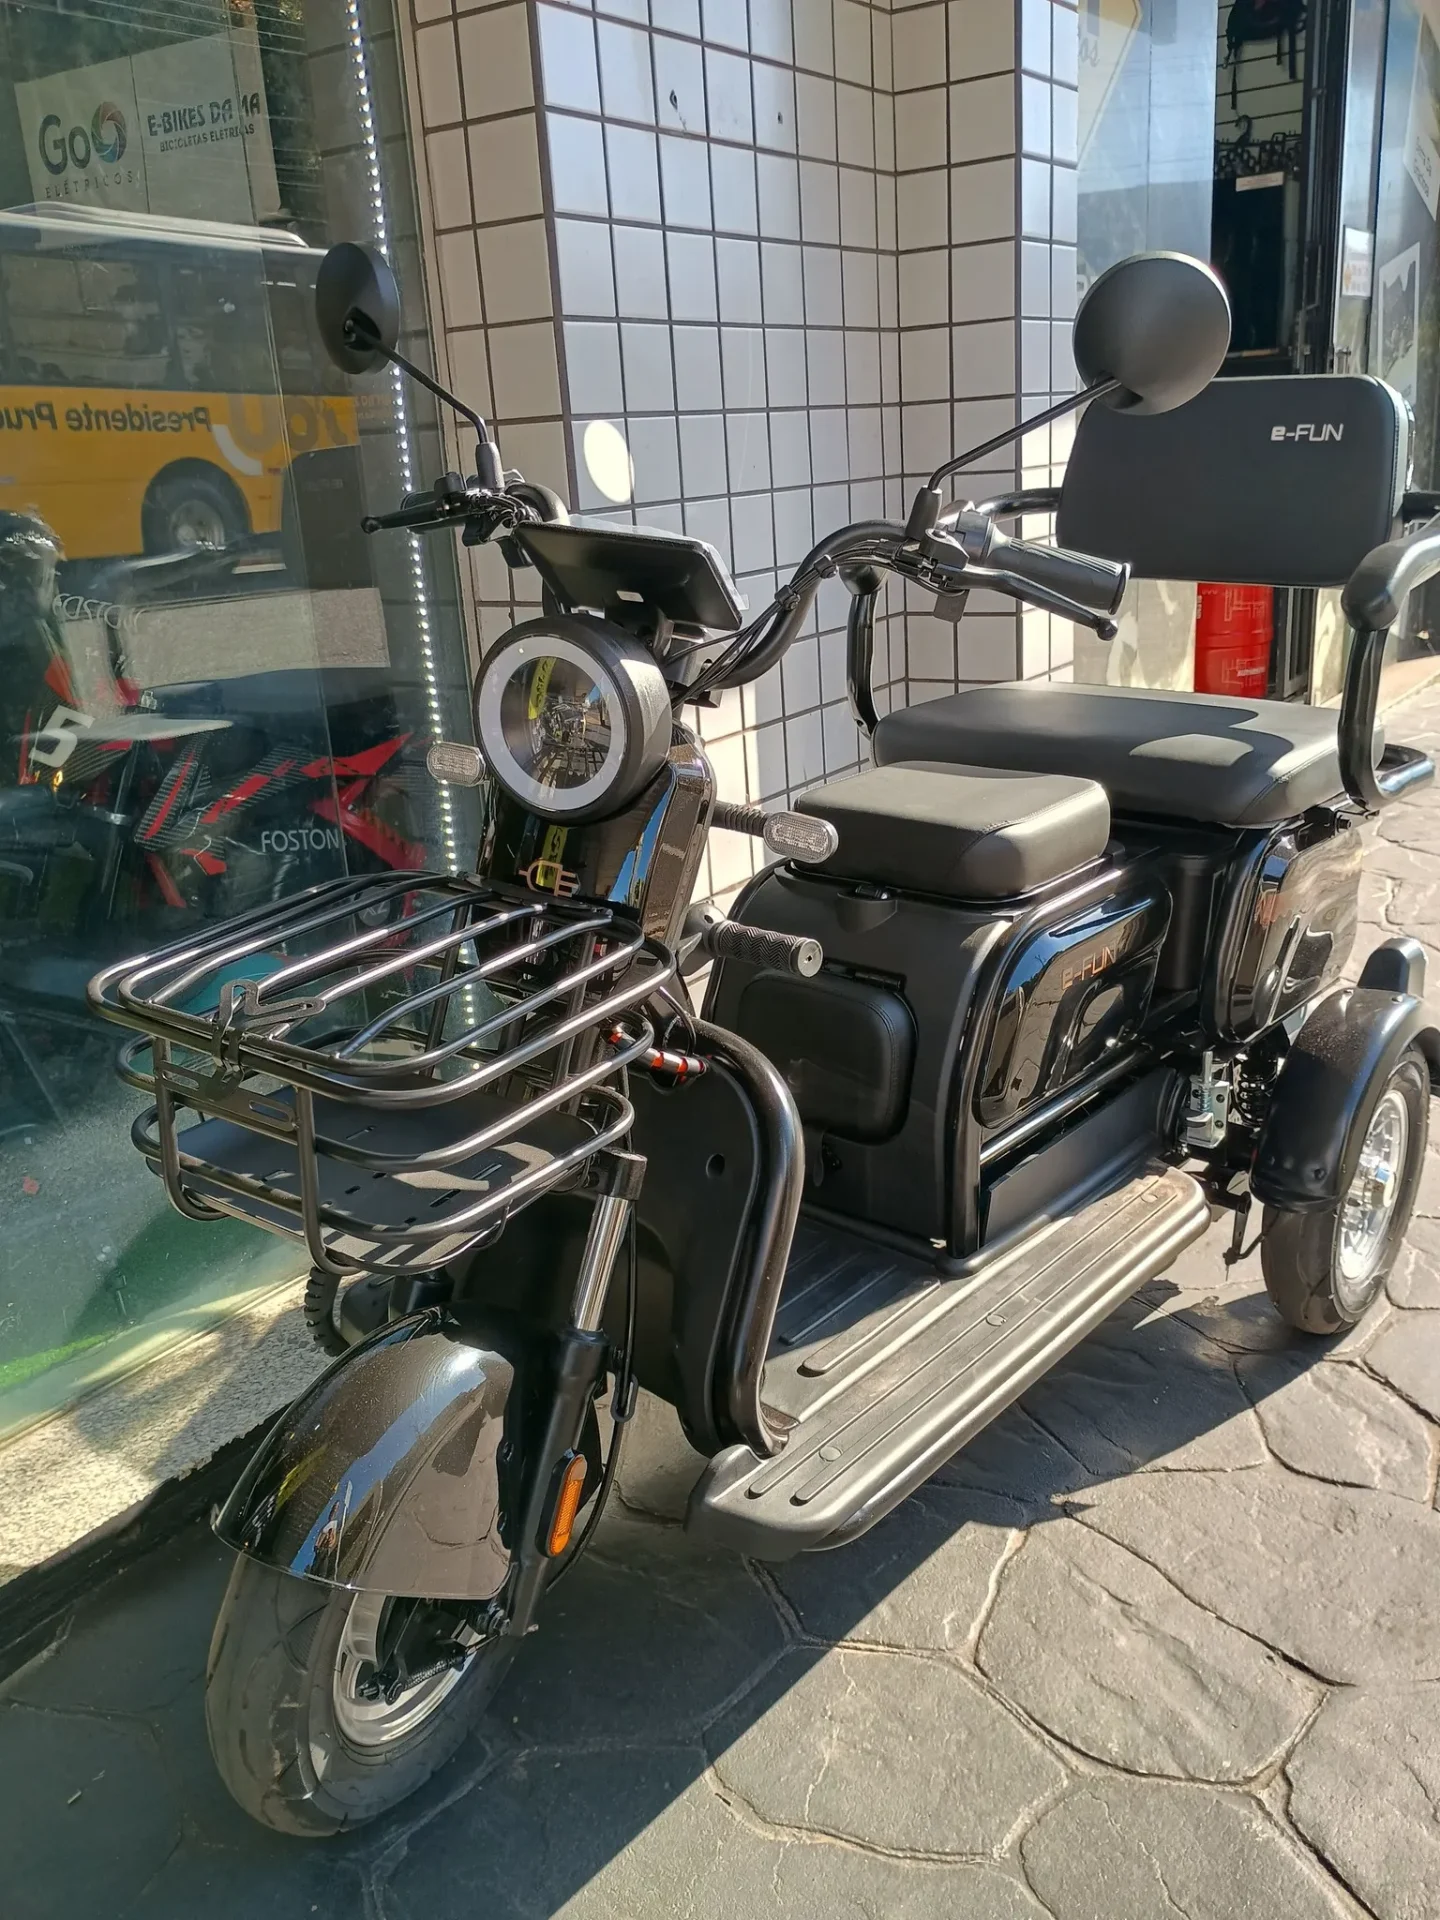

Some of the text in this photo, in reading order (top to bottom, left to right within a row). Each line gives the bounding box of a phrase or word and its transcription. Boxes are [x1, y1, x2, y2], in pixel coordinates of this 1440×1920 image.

[147, 104, 206, 137] E-BIKES
[209, 98, 233, 125] DA
[160, 132, 208, 152] BICICLETAS
[261, 828, 341, 853] FOSTON
